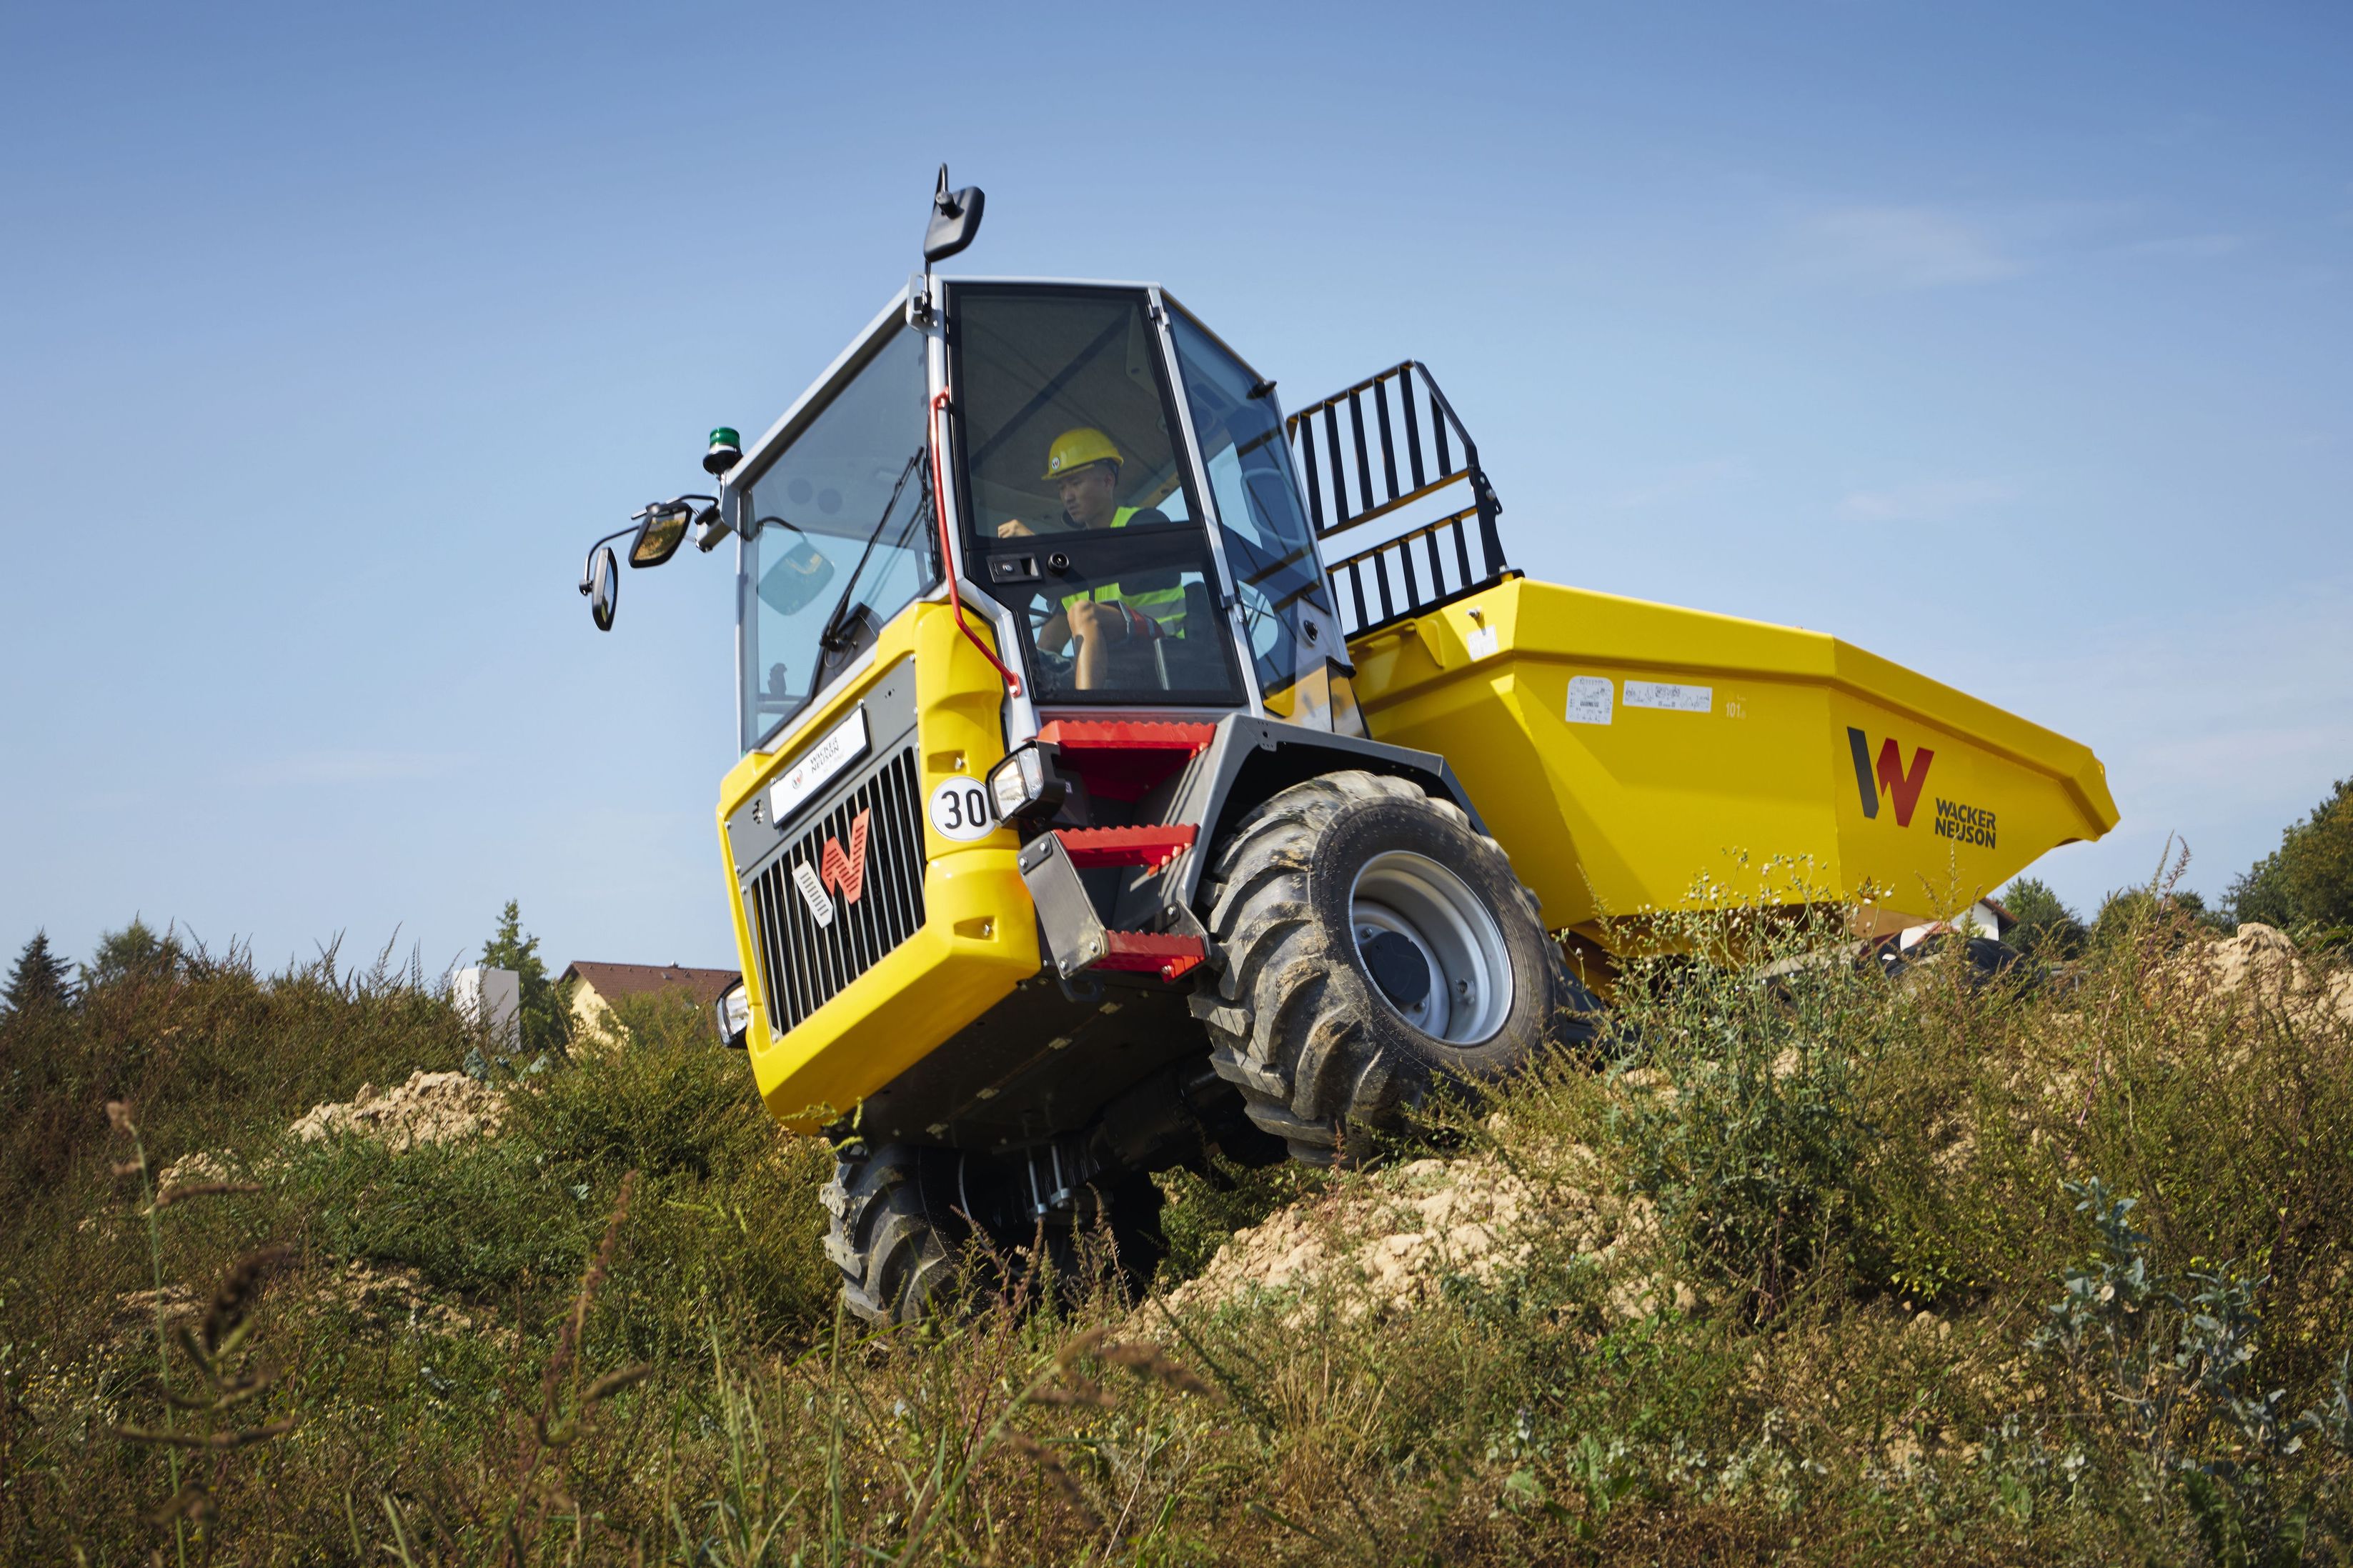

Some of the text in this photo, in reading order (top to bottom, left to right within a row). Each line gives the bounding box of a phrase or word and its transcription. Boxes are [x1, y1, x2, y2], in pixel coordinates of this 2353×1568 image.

[811, 744, 840, 774] NEUSON
[940, 789, 986, 830] 30
[1935, 797, 1996, 831] WACKER
[1934, 817, 1996, 849] NEUSON
